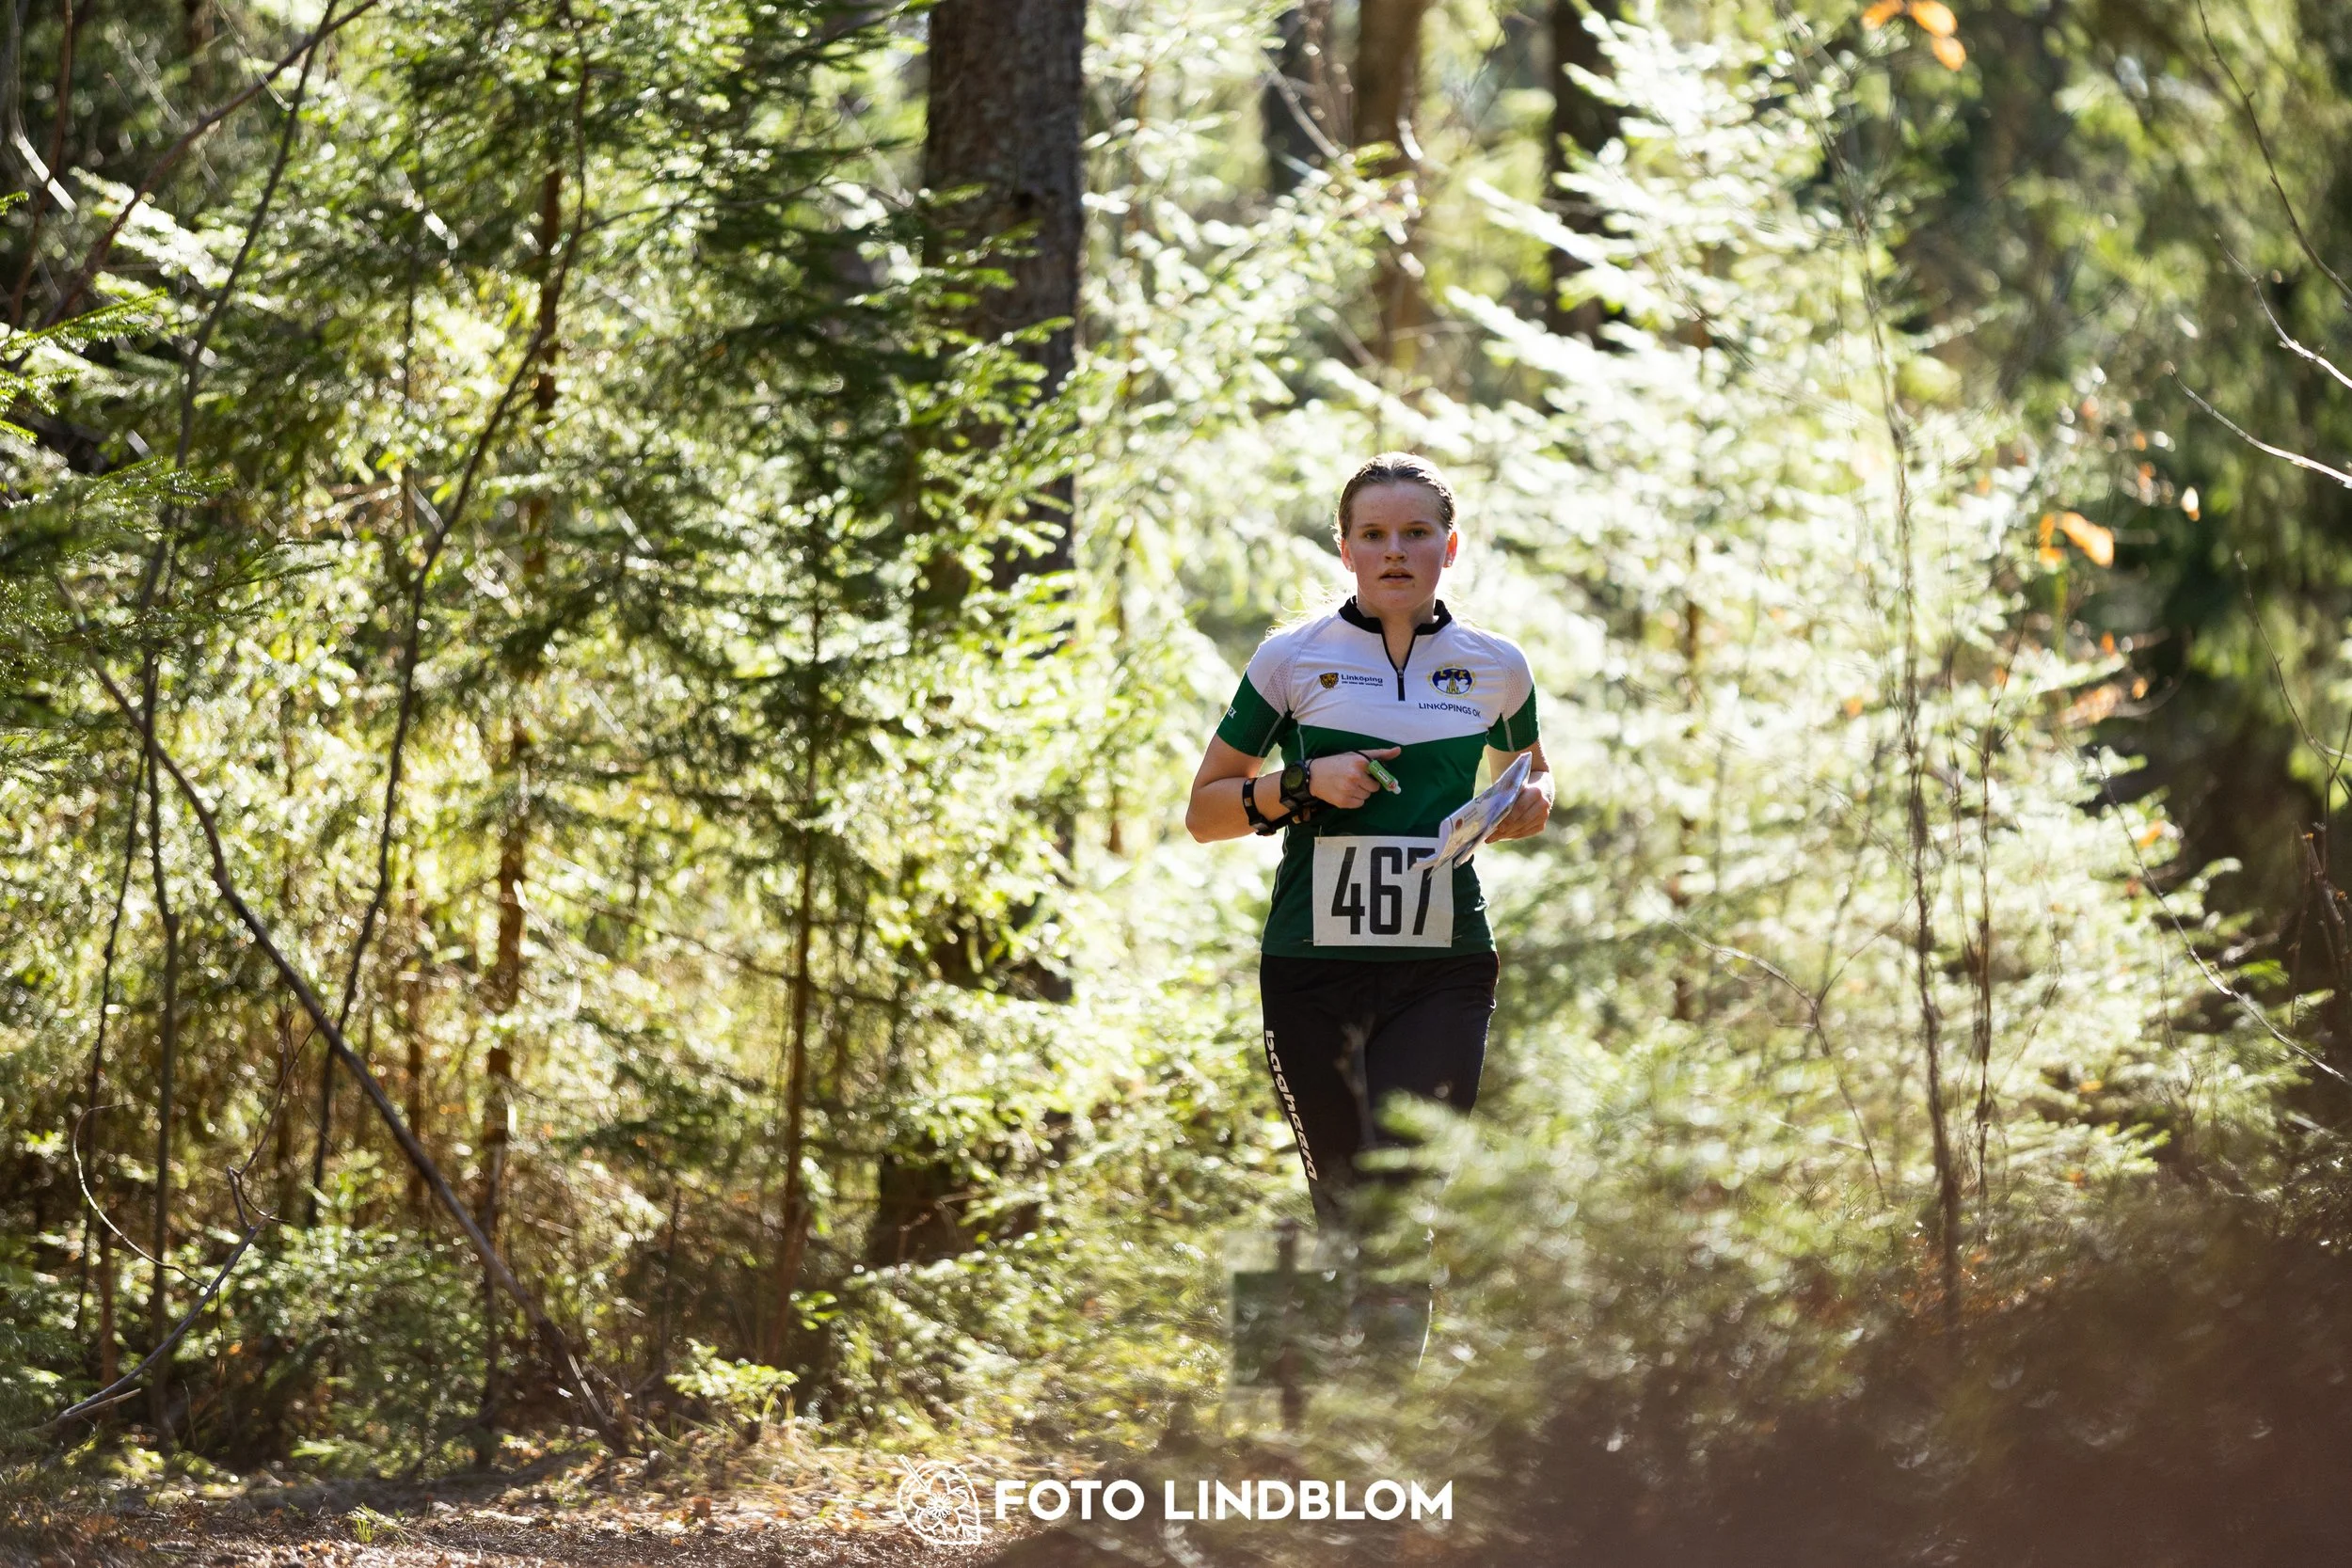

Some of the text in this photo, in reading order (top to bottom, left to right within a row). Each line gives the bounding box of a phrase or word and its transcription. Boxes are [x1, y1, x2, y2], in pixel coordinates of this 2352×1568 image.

[1341, 673, 1383, 683] Linköping
[1419, 702, 1472, 716] LINKÖPINGS
[1331, 847, 1436, 936] 467
[1264, 1030, 1318, 1181] bagheera
